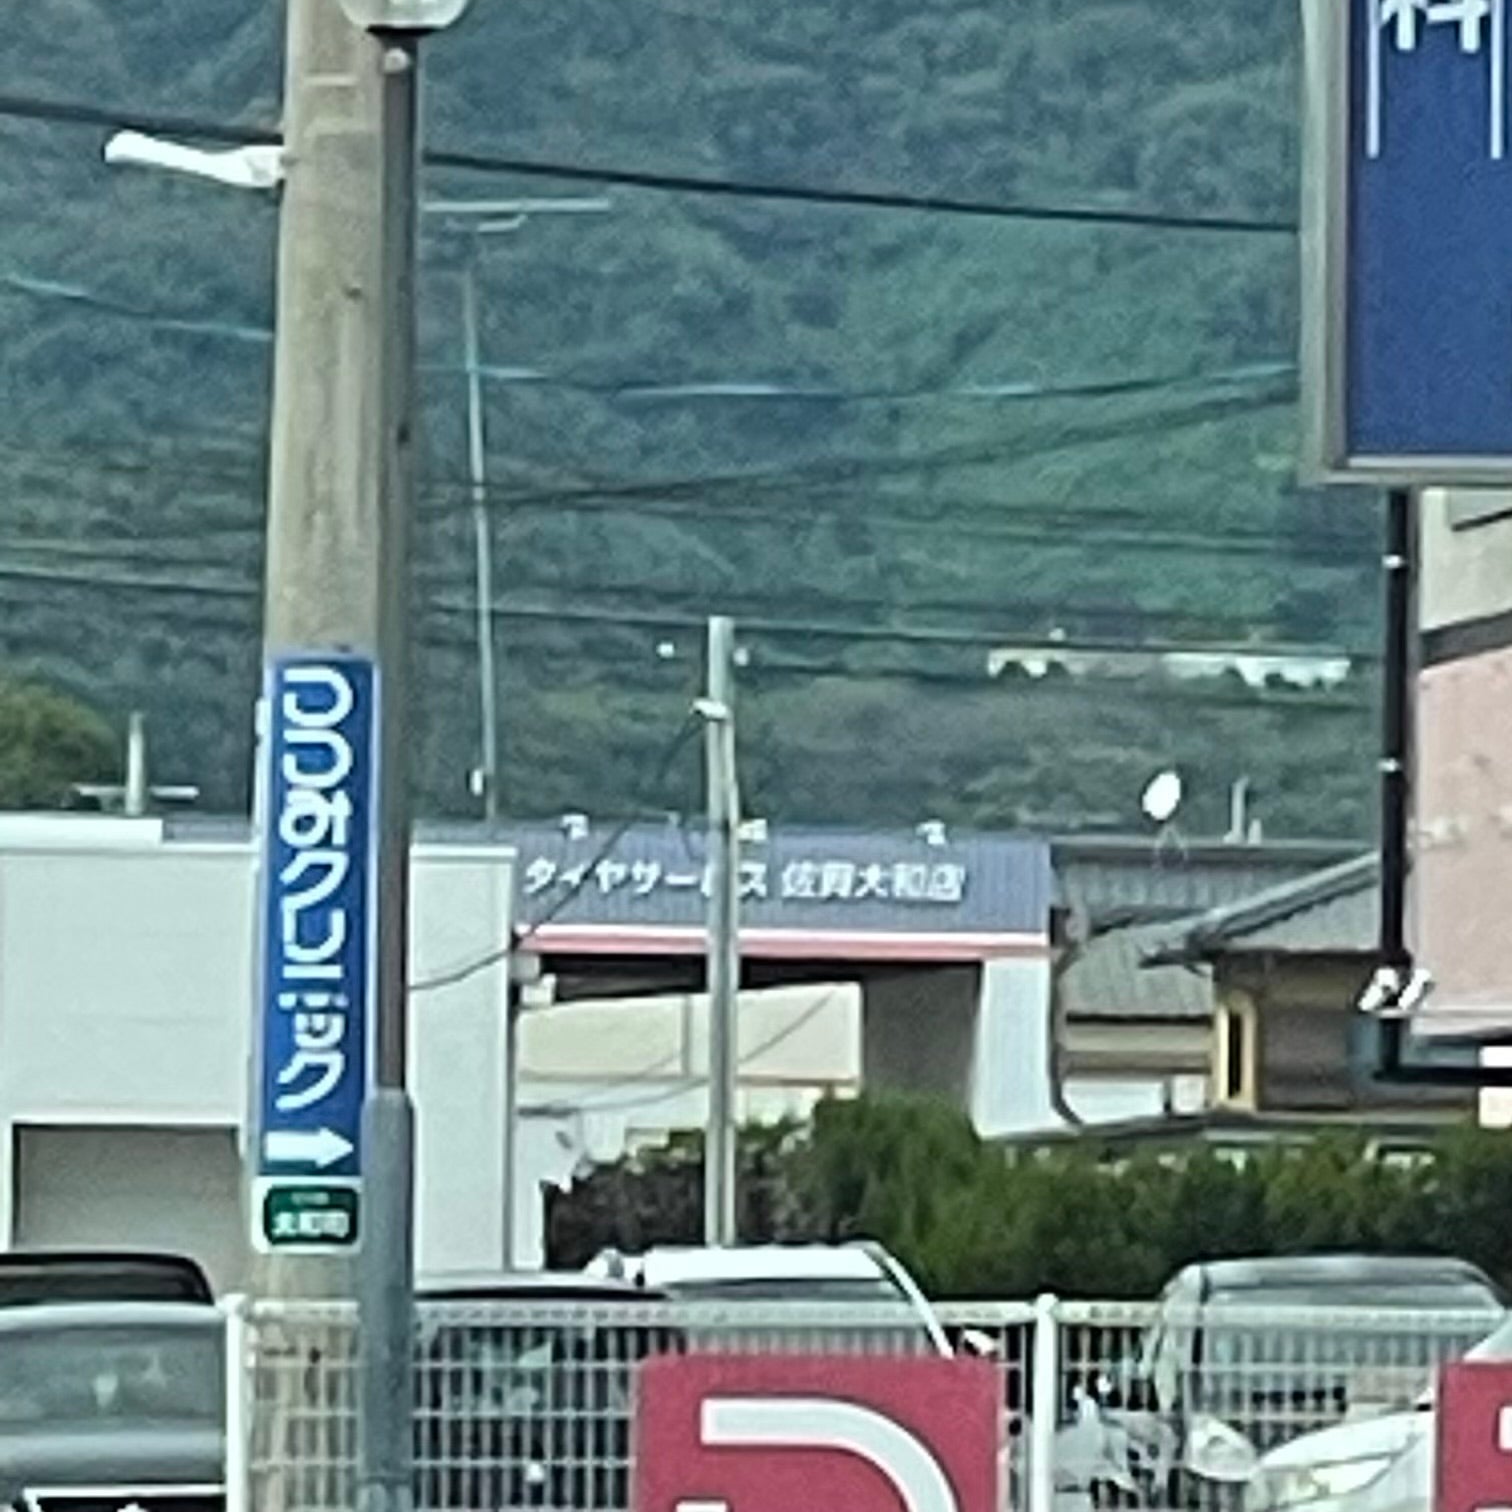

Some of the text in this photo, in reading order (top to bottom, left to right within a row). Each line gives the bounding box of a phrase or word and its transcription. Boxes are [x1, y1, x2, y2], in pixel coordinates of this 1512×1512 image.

[277, 667, 354, 1110] つつみクリニック
